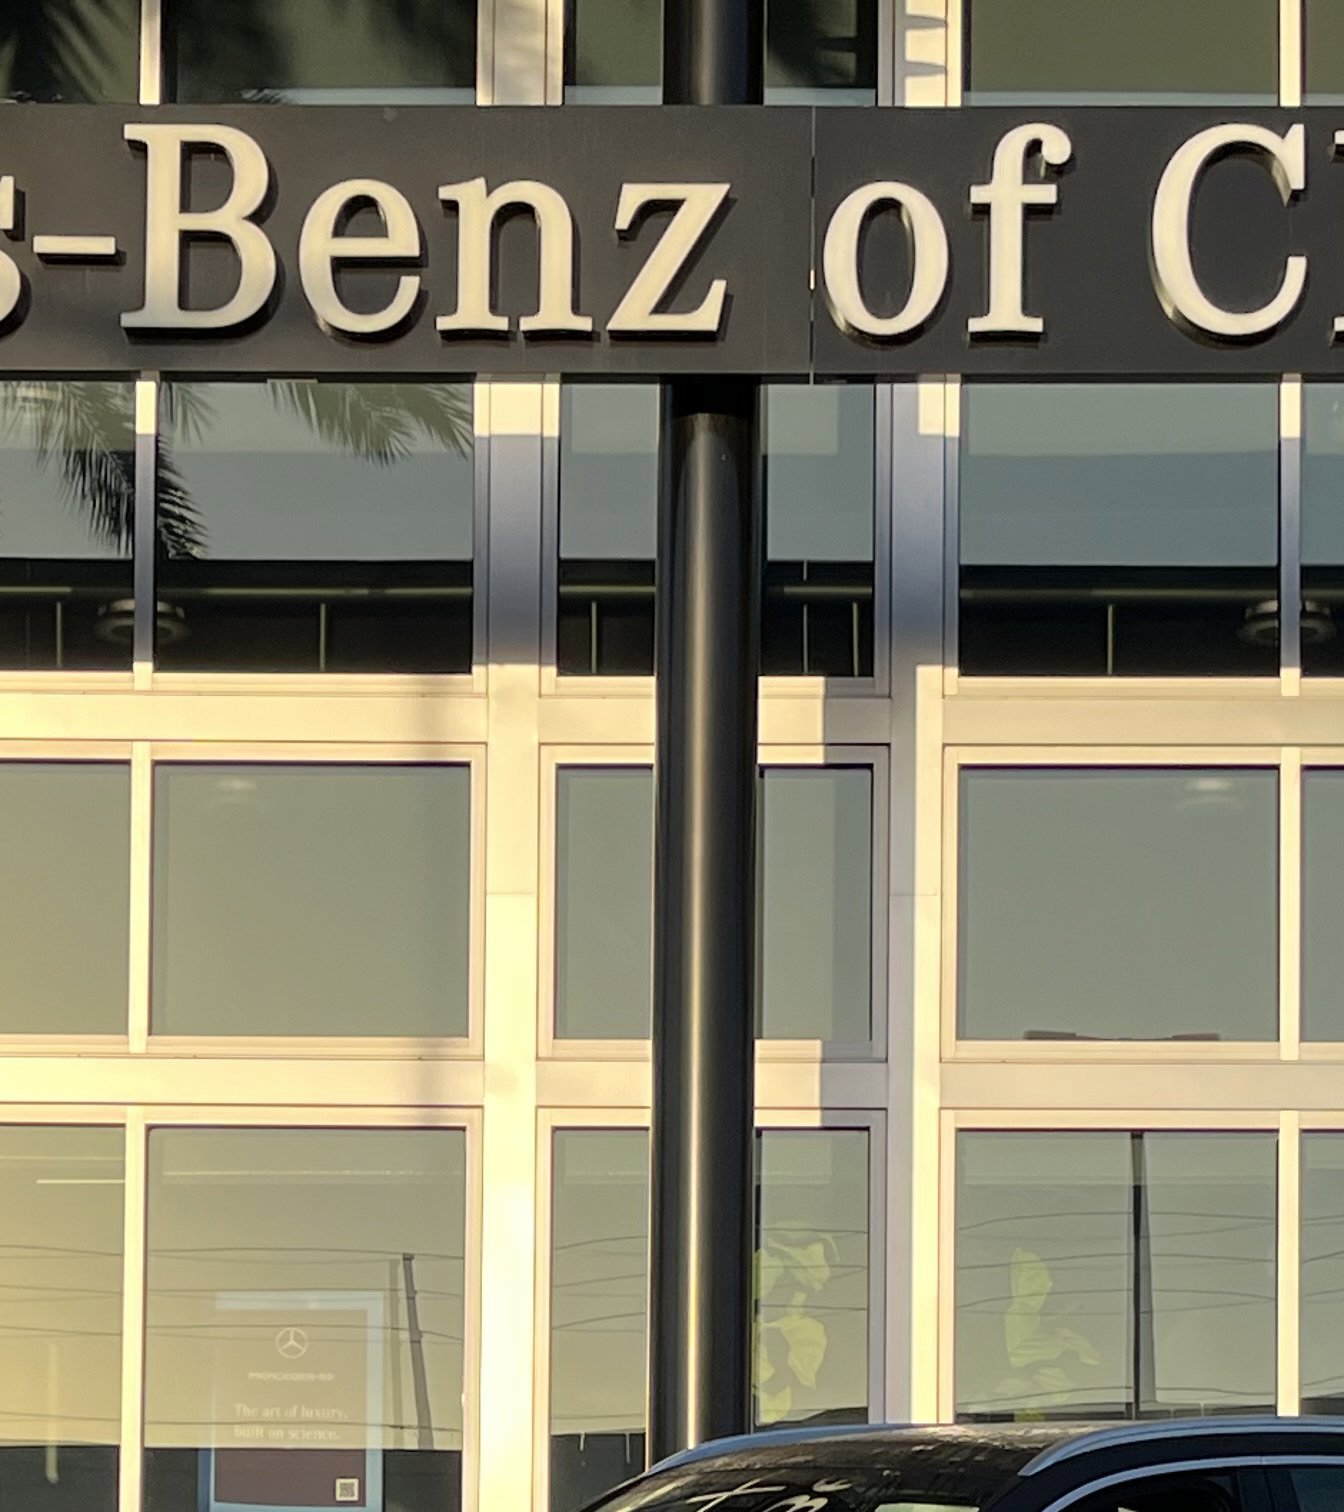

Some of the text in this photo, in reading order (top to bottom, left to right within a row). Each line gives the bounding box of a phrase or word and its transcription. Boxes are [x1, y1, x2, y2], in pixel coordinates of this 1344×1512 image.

[822, 122, 1072, 336] of
[233, 1402, 348, 1420] The art of luxury,
[268, 1428, 284, 1440] on
